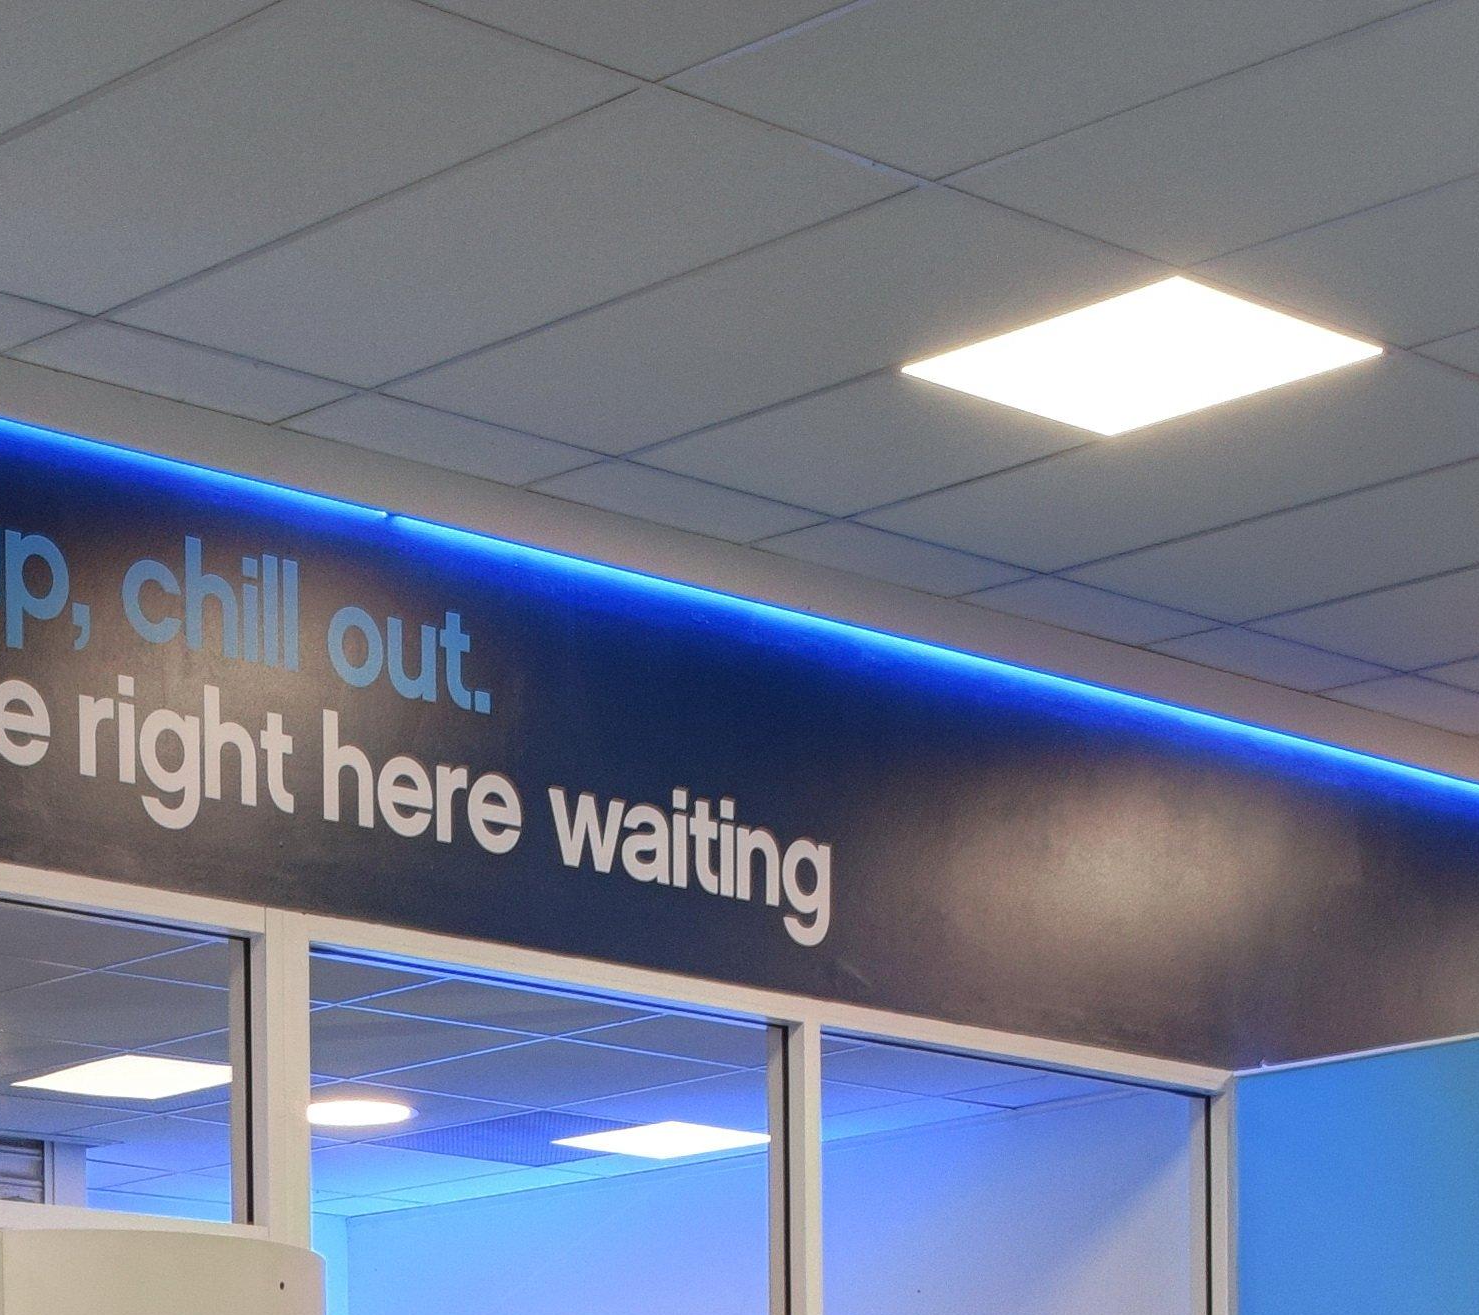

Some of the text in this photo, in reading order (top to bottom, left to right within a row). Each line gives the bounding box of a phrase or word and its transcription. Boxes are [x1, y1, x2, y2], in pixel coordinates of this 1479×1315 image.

[120, 535, 299, 672] chill
[326, 601, 491, 715] out.
[77, 674, 296, 831] right
[321, 708, 522, 856] here
[547, 785, 833, 948] waiting
